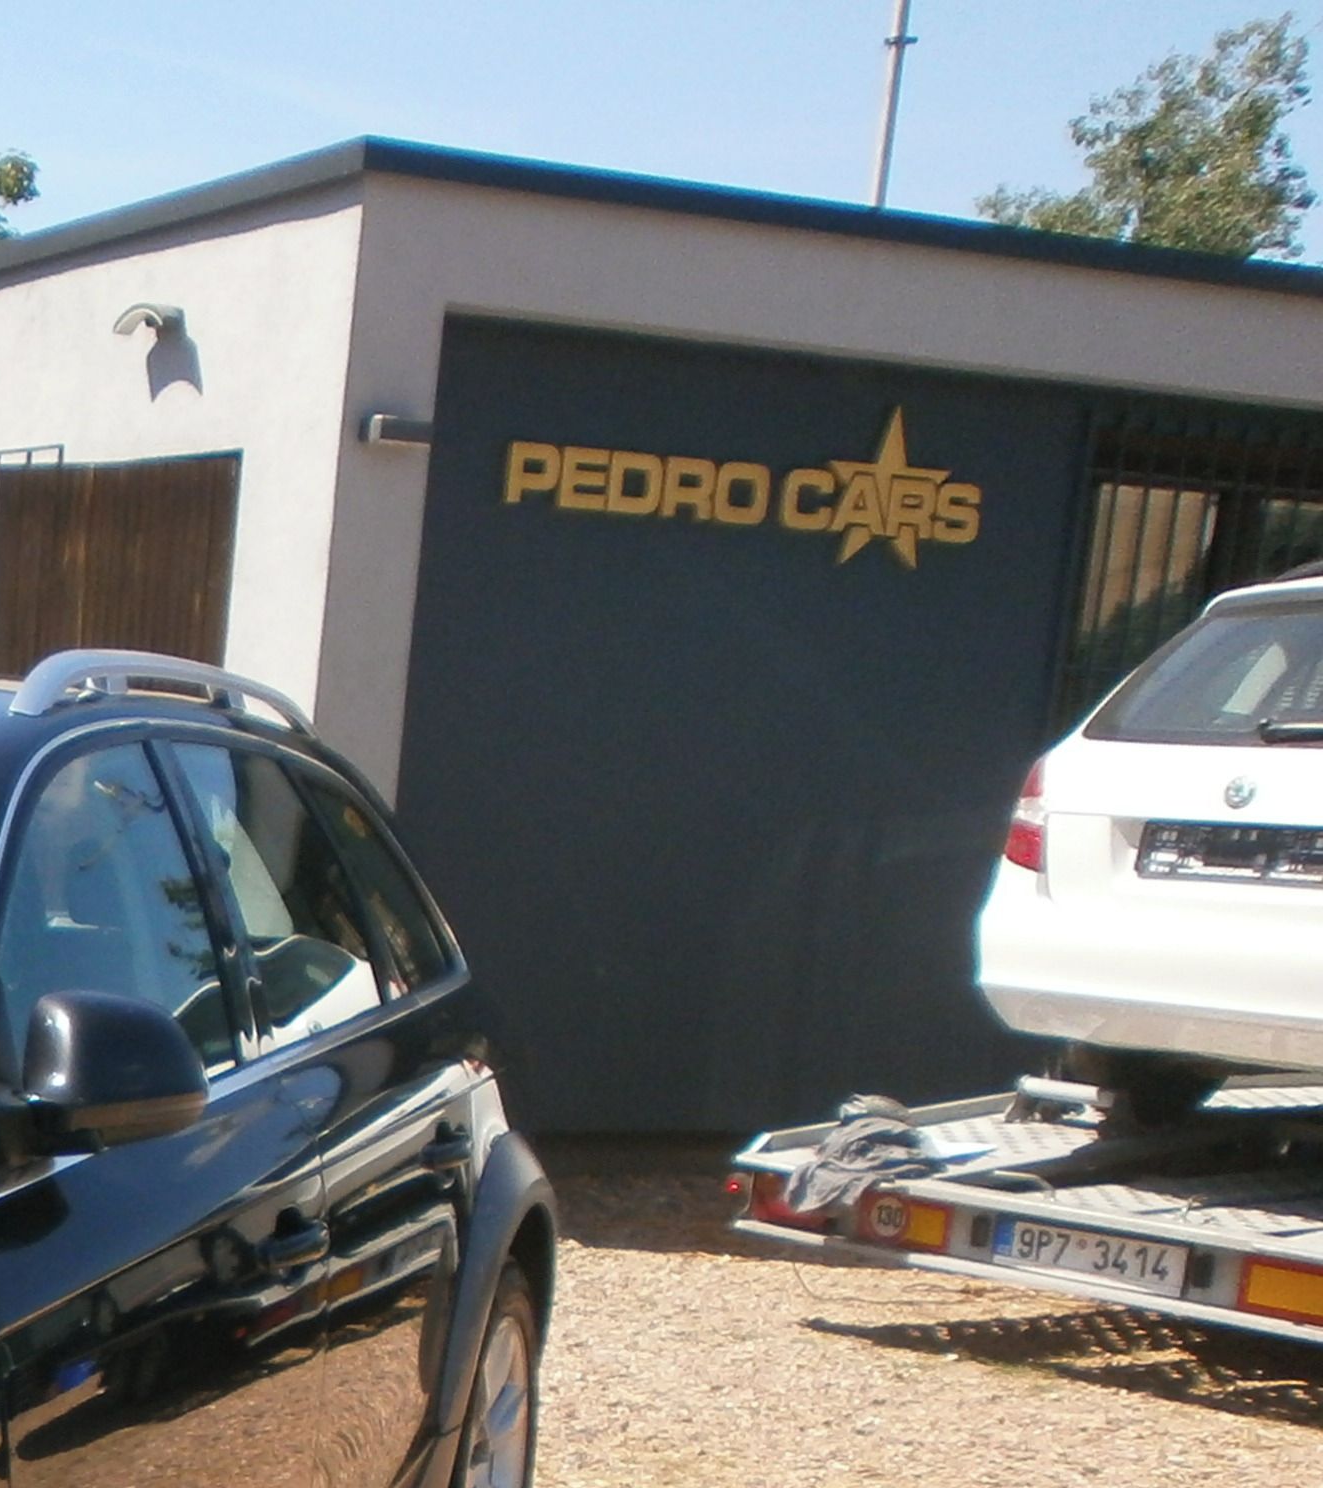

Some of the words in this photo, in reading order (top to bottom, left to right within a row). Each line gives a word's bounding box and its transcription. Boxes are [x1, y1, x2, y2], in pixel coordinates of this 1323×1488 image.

[502, 440, 770, 526] PEDRO
[780, 464, 982, 545] CARS
[1016, 1227, 1072, 1265] 9P7
[1092, 1239, 1169, 1281] 3414
